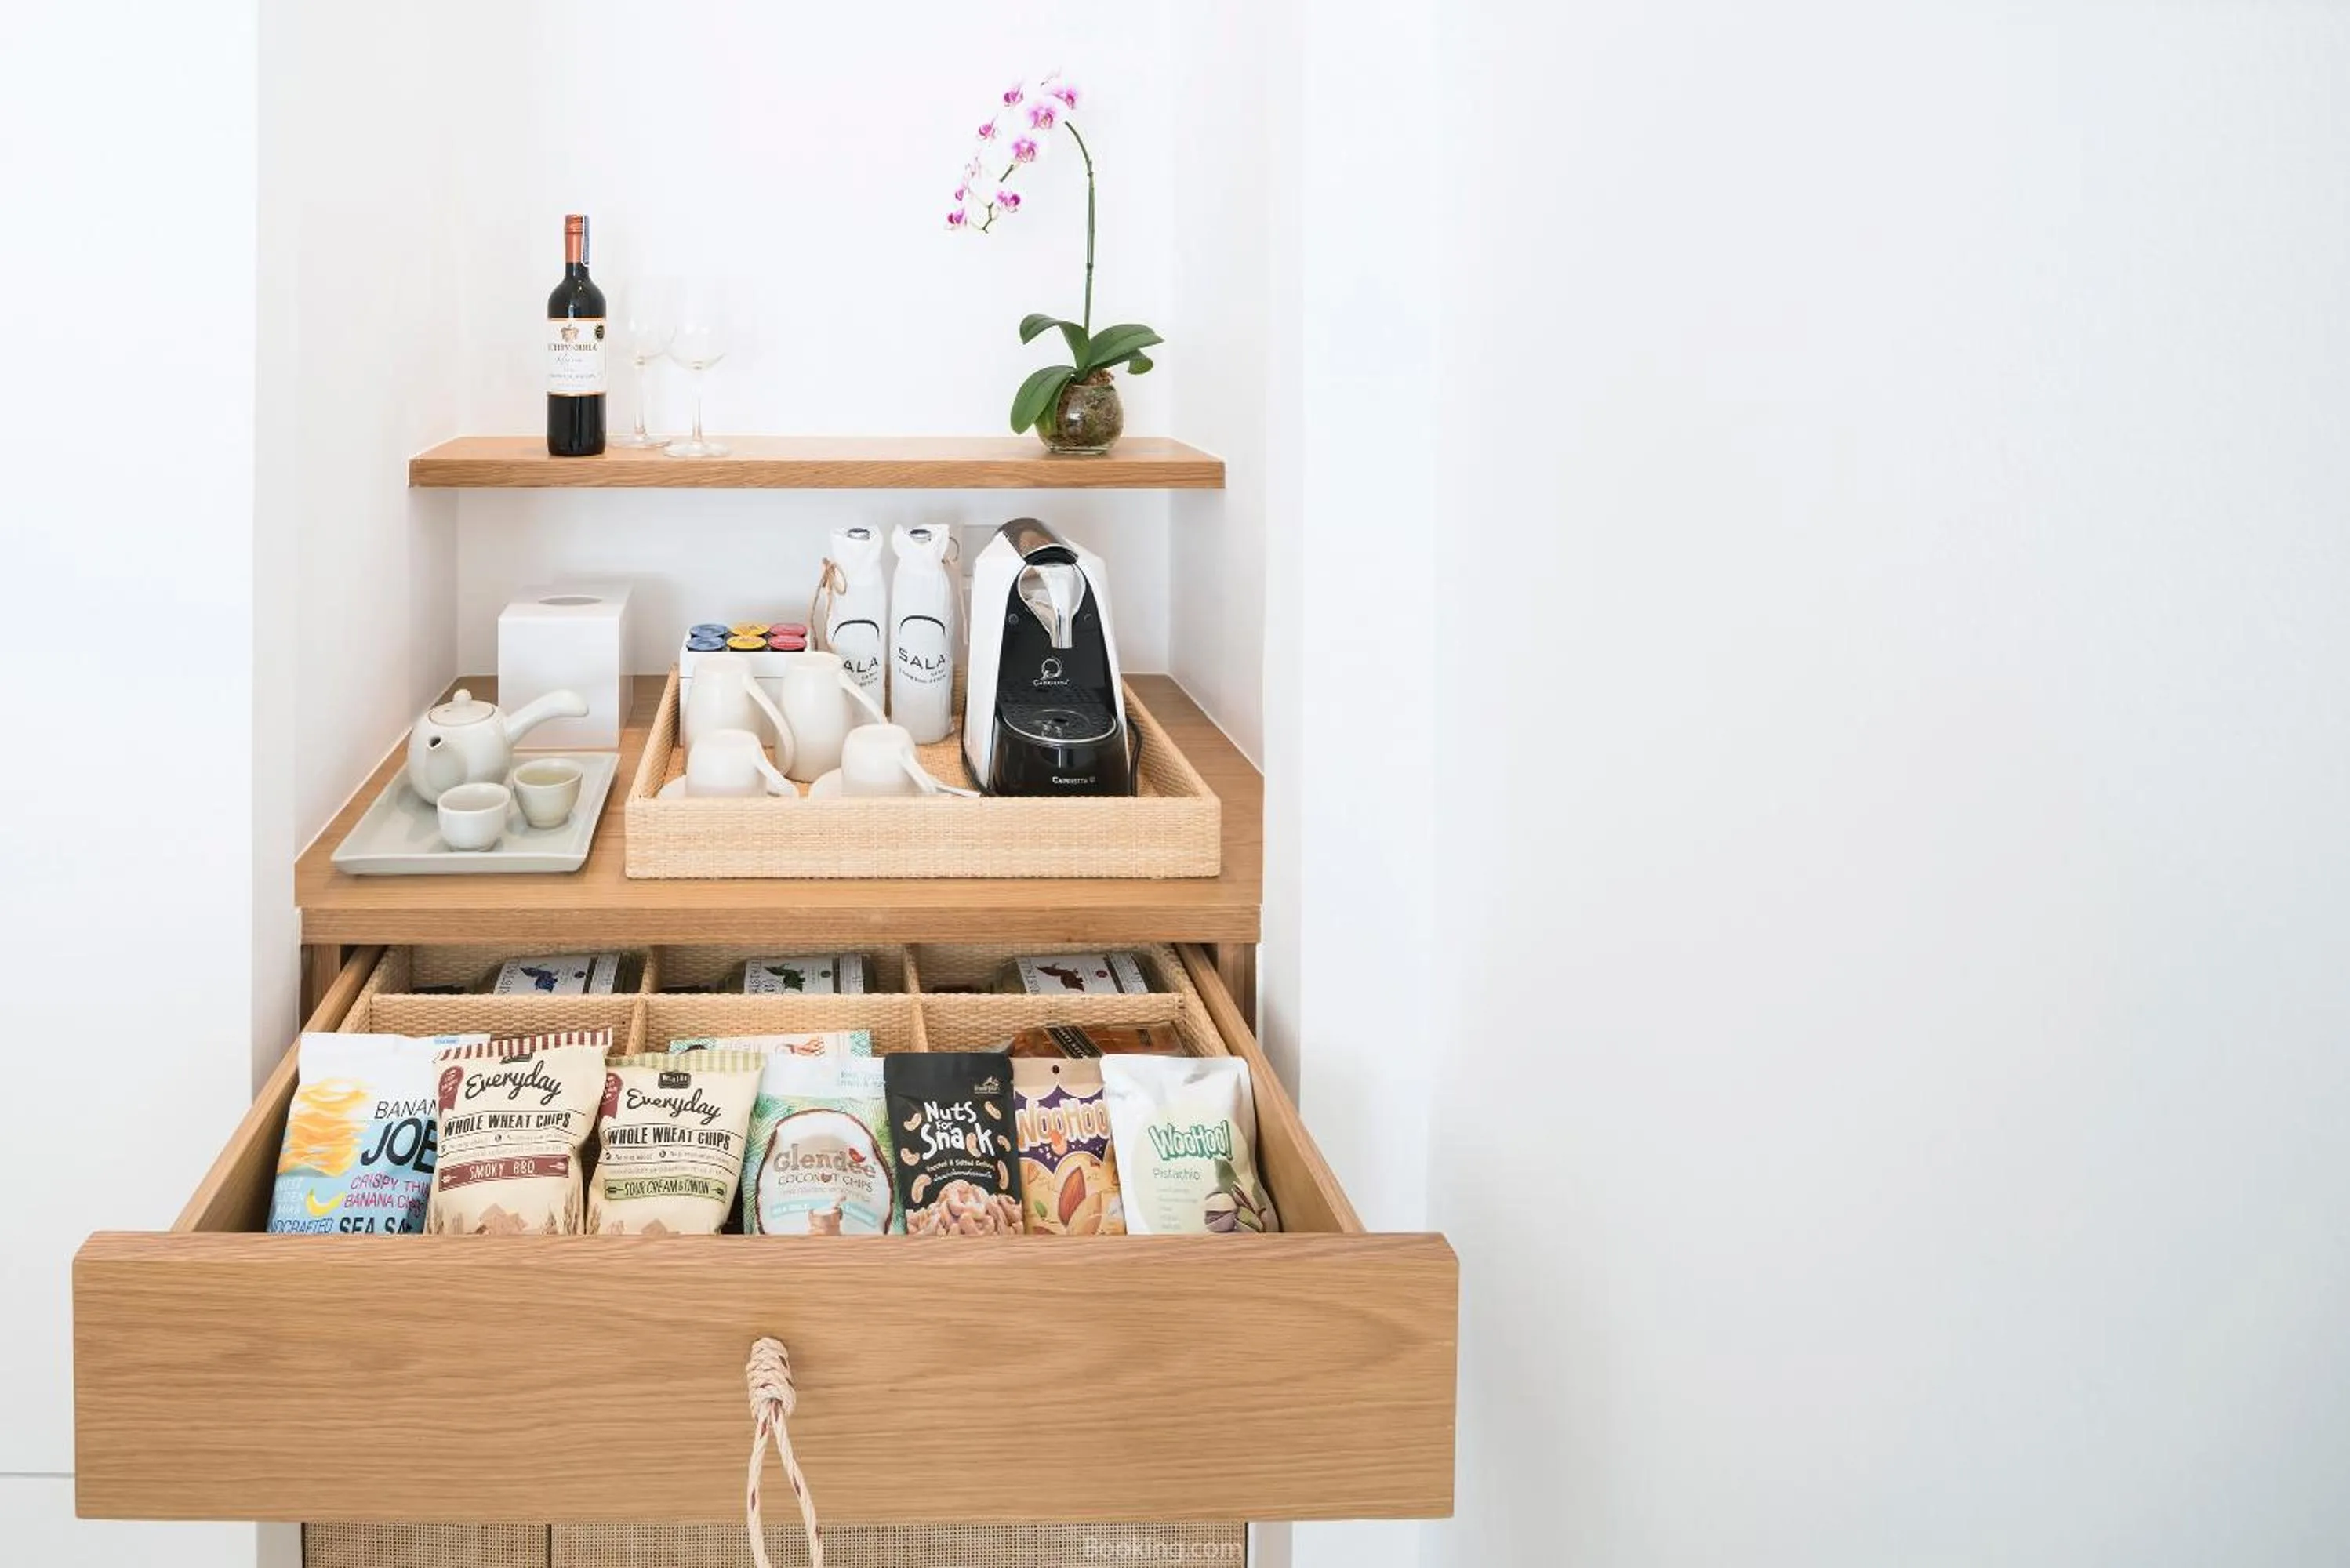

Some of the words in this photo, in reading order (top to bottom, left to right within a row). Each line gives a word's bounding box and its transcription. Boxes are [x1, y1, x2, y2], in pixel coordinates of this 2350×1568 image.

[899, 647, 946, 670] SALA
[465, 1060, 561, 1105] Everyday
[627, 1088, 721, 1125] Everyday
[444, 1115, 483, 1137] WHOLE
[489, 1113, 532, 1129] WHEAT
[536, 1112, 571, 1129] CHIPS
[607, 1127, 648, 1145] WHOLE
[653, 1127, 693, 1144] WHEAT
[698, 1131, 731, 1151] CHIPS
[469, 1163, 506, 1180] SMOKY
[513, 1160, 536, 1174] BBQ
[773, 1143, 876, 1178] Glendee
[351, 1174, 398, 1190] CRISPY
[778, 1173, 837, 1185] COCONUT
[842, 1175, 874, 1192] CHIPS
[344, 1192, 394, 1209] BANANA
[339, 1217, 376, 1233] SEA
